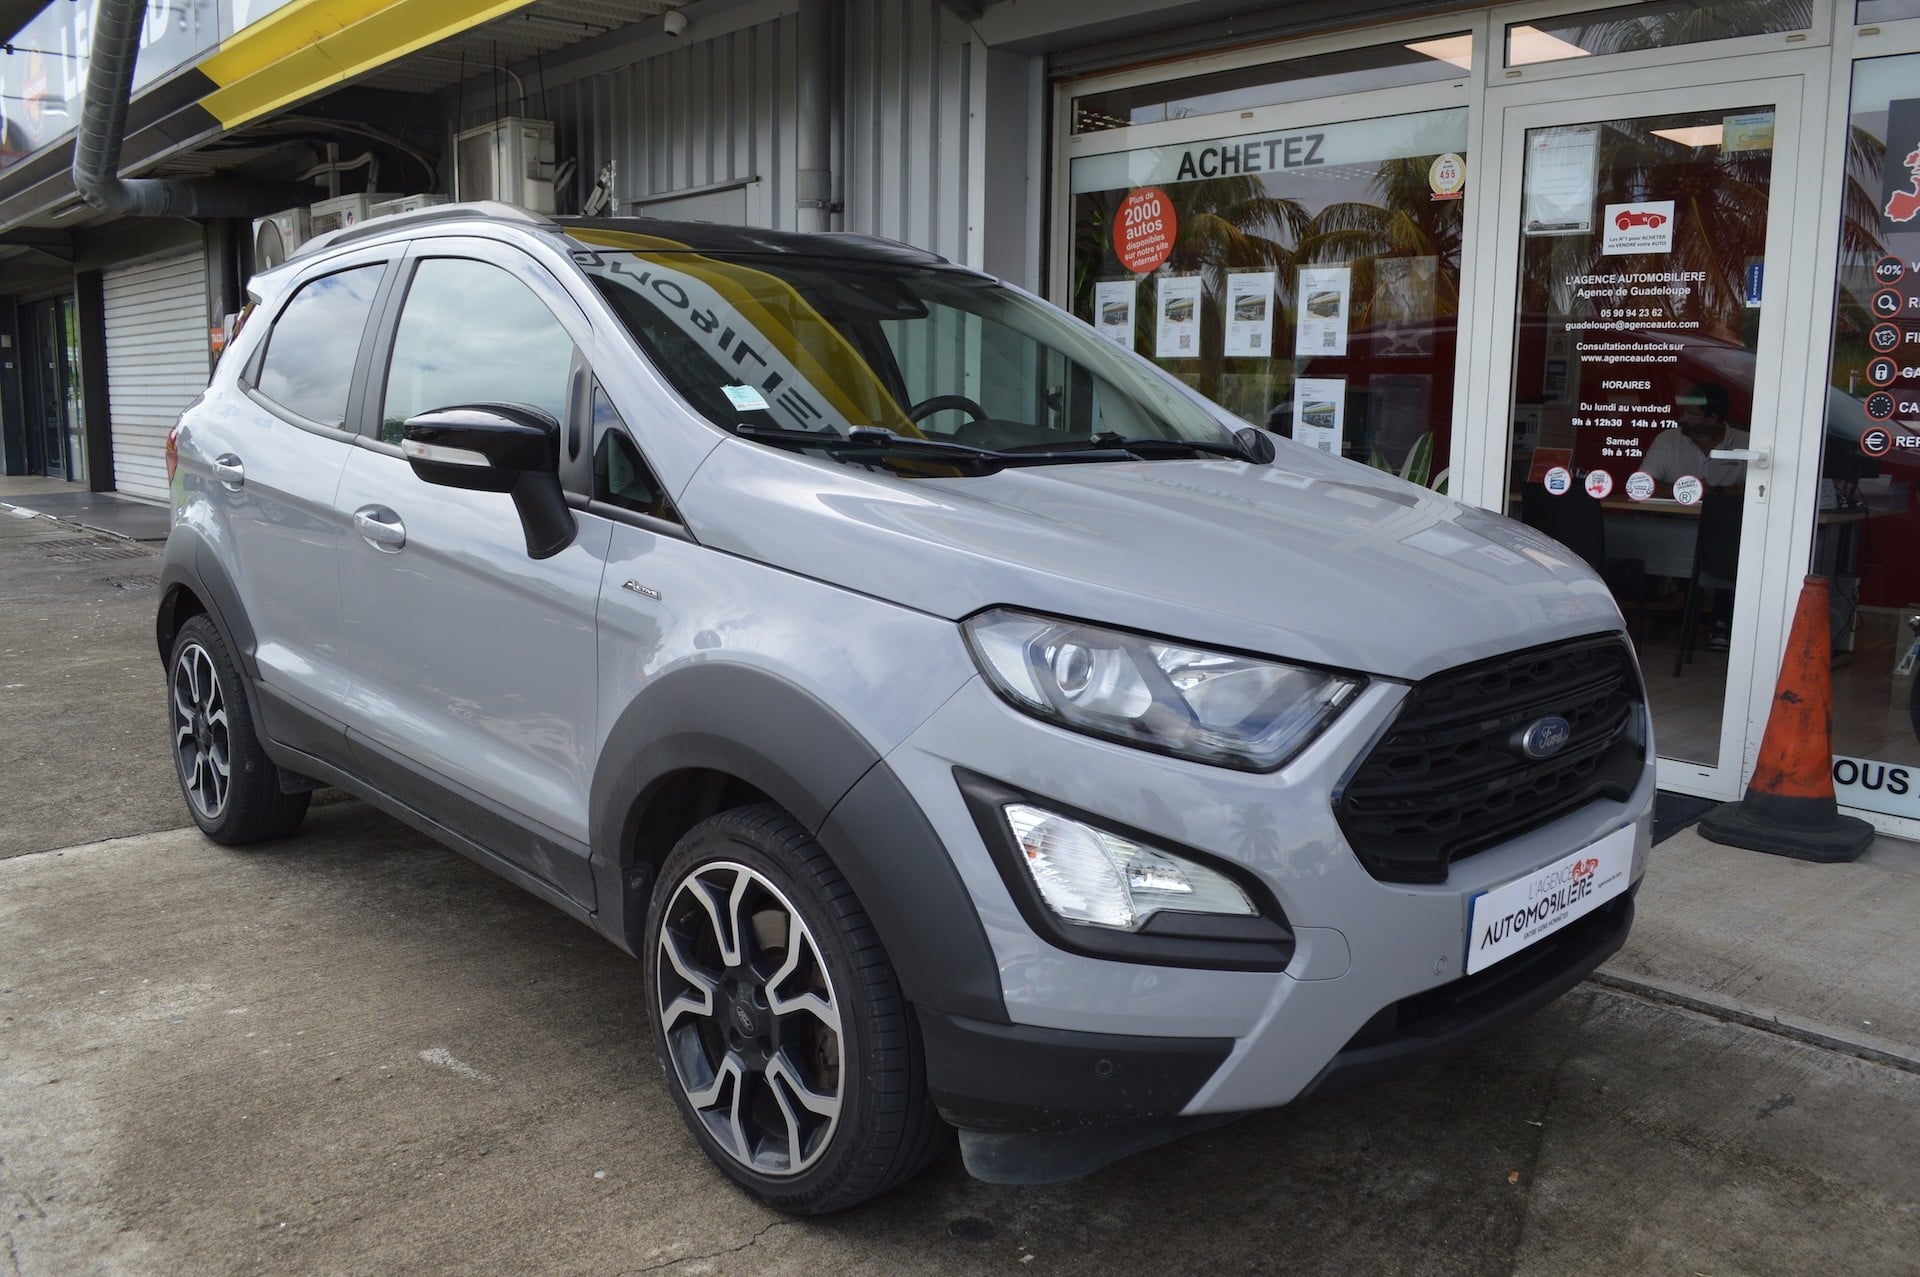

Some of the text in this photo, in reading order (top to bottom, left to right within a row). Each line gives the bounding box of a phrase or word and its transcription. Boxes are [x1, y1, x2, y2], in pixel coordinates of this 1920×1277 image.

[1177, 133, 1325, 181] ACHETEZ
[1128, 191, 1154, 205] Plus de
[1124, 199, 1161, 226] 2000
[1126, 219, 1163, 240] autos
[1126, 233, 1165, 251] disponibles
[1124, 242, 1169, 261] sur notre site
[1132, 253, 1159, 267] internet
[1876, 264, 1902, 275] 40%
[1565, 271, 1706, 285] L'AGENCE AUTOMOBILIERE
[1577, 286, 1691, 299] Agence de Guadeloupe
[1600, 308, 1663, 318] 05 90 94 23 62
[1565, 320, 1699, 331] guadeloupe@agenceauto.com
[1581, 354, 1677, 363] www.agenceauto.com
[1602, 380, 1651, 389] HORAIRES
[1580, 402, 1671, 413] Du lundi au vendredi
[1571, 417, 1678, 429] 9h à 12h30 14h à 17h
[1606, 436, 1639, 446] Samedi
[1602, 448, 1642, 457] 9h à 12h
[1528, 864, 1574, 900] L'AGENCE
